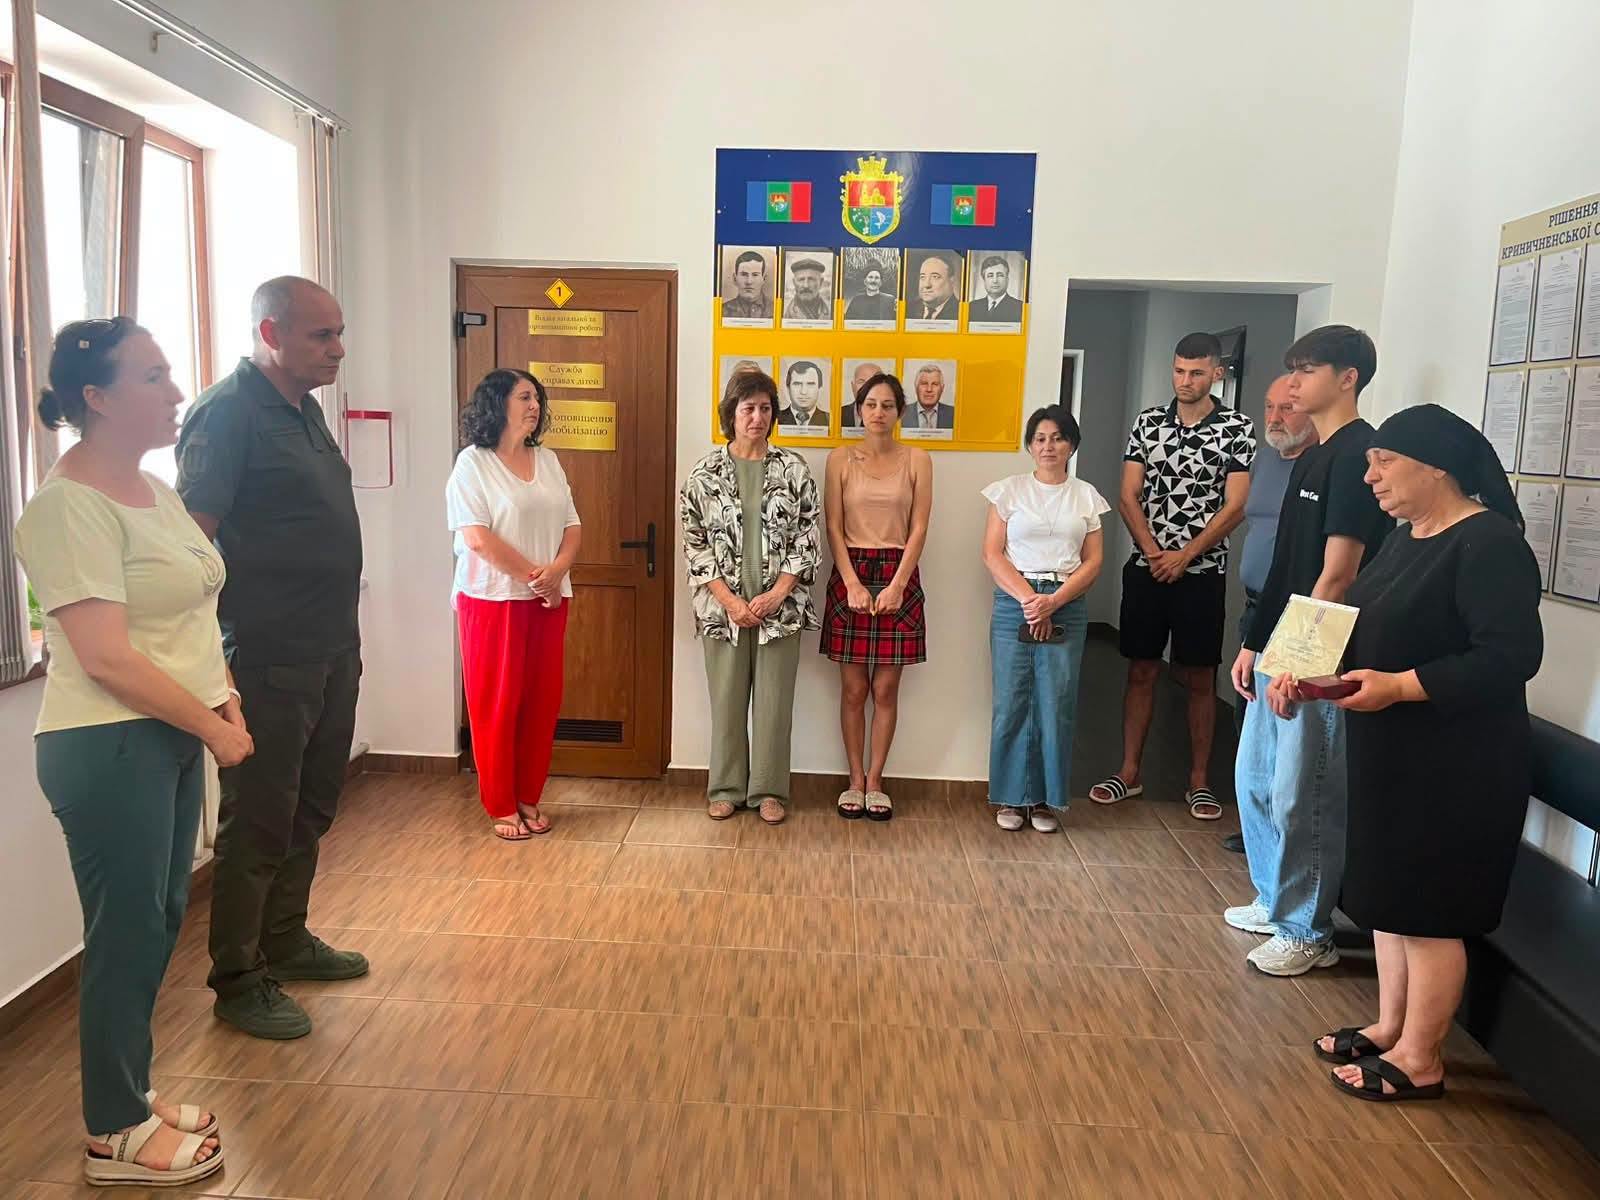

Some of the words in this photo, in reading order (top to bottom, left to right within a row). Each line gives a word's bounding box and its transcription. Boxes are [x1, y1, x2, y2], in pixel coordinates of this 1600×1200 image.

[1548, 201, 1599, 227] РІШЕННЯ
[1501, 222, 1592, 260] КРИНИЧНЕНСЬКОЇ
[555, 286, 562, 297] 1
[548, 365, 583, 376] Служба
[576, 377, 600, 386] дітей
[554, 414, 613, 424] оповіщення
